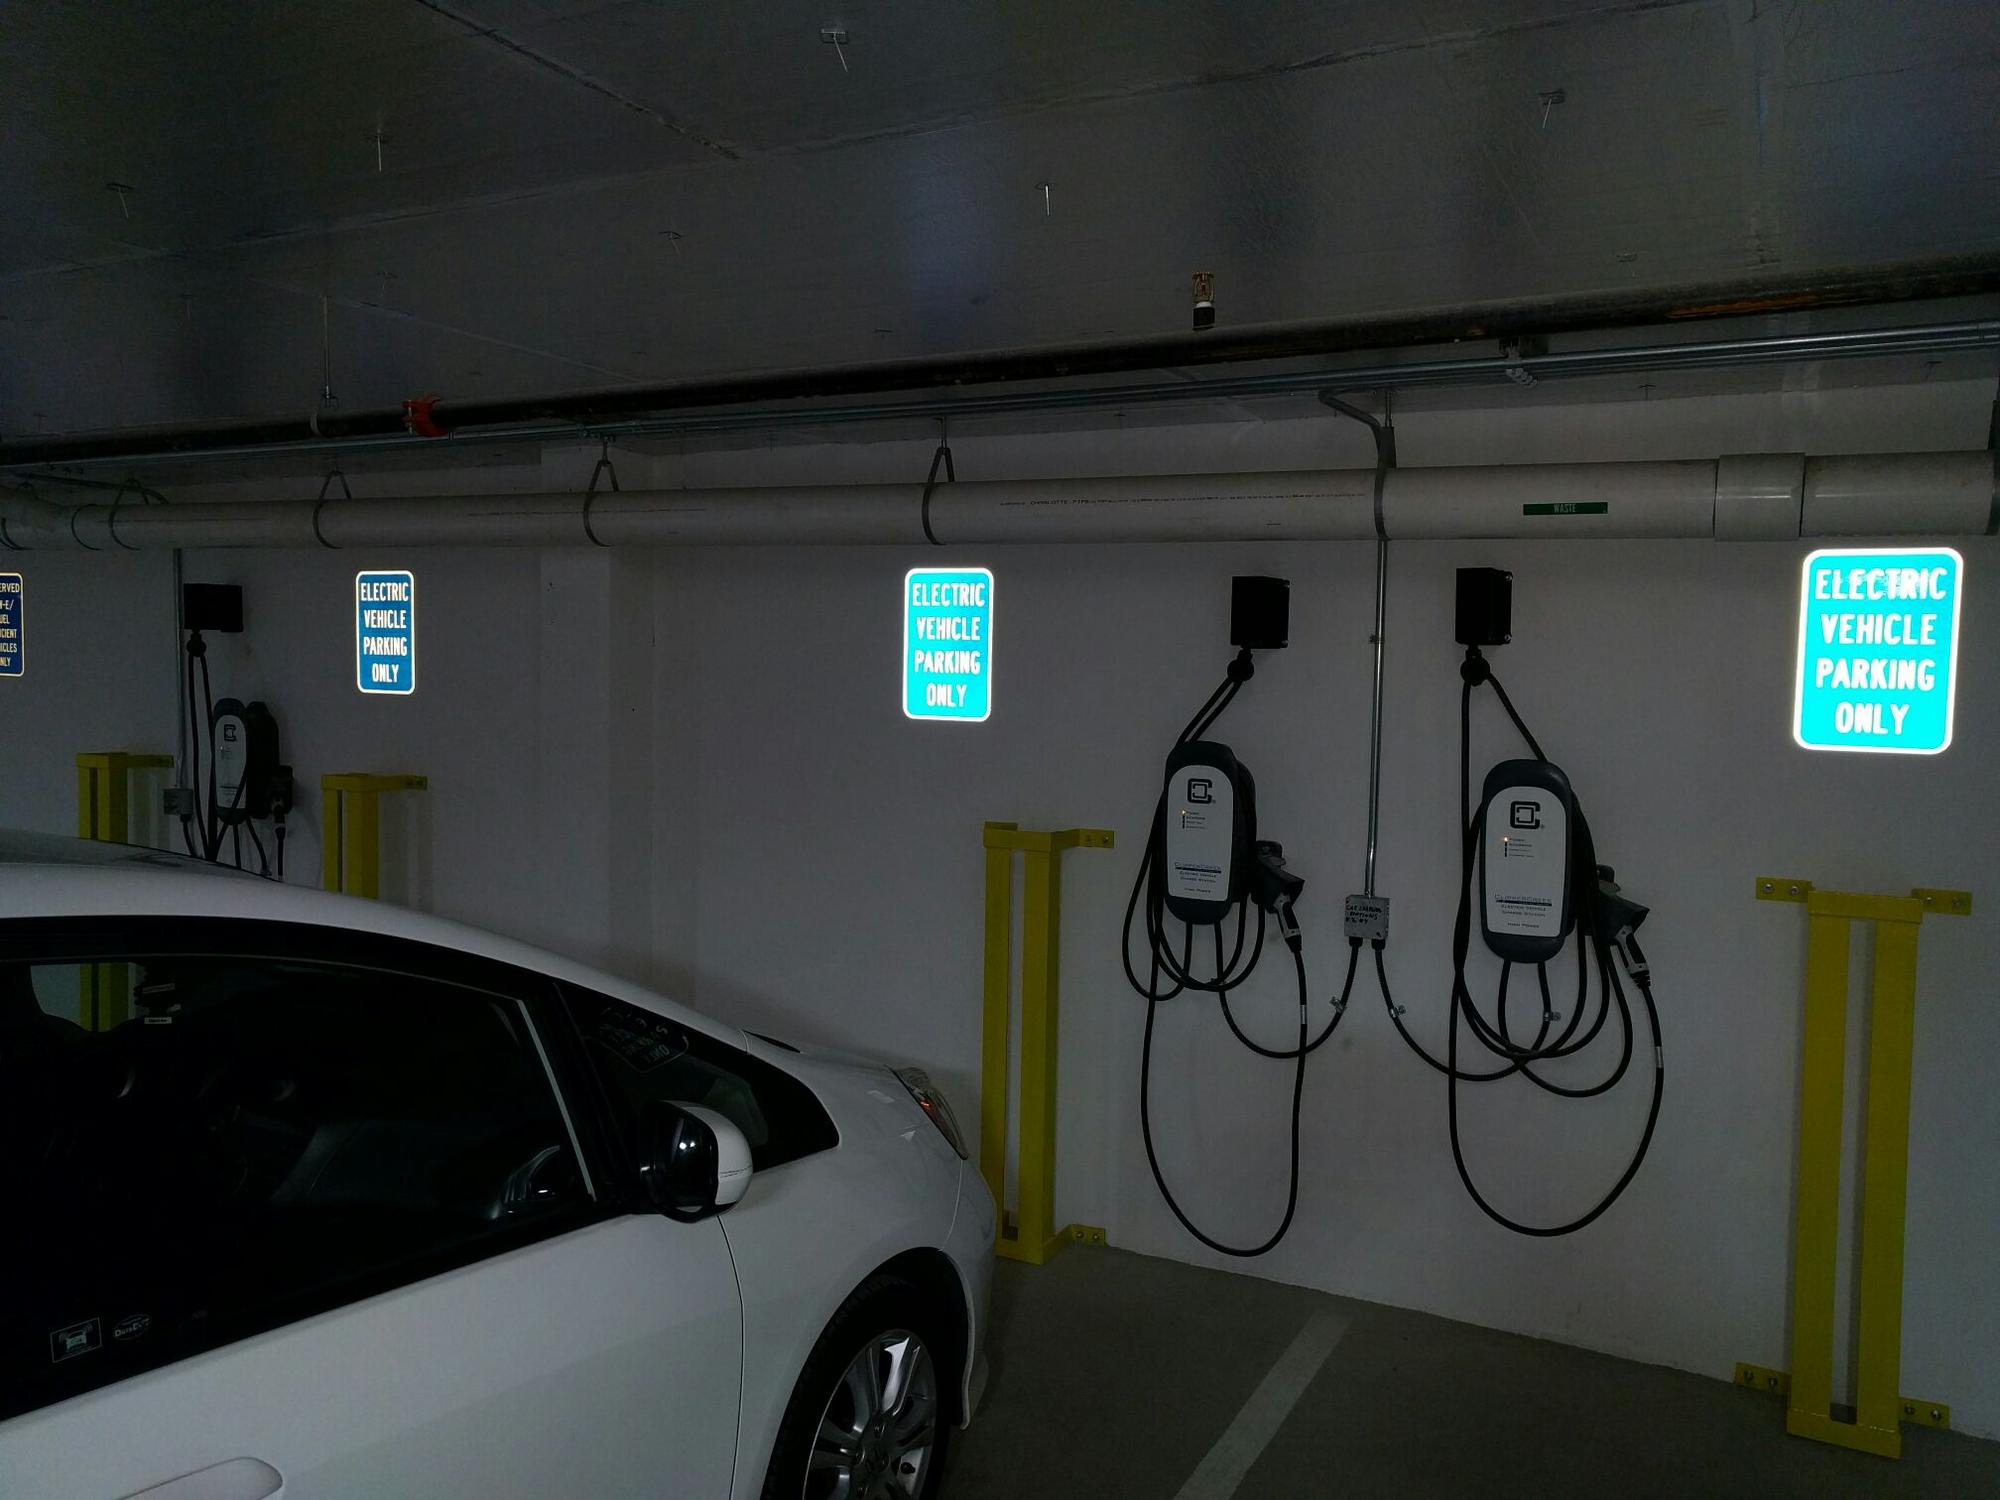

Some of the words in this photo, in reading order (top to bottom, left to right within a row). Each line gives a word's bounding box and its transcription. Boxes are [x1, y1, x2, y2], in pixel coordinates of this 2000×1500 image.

[1553, 503, 1577, 513] WASTE
[361, 582, 409, 602] ELECTRIC
[912, 582, 986, 607] ELECTRIC
[1815, 567, 1948, 601] ELECTRIC
[363, 609, 407, 629] VEHICLE
[916, 616, 981, 641] VEHICLE
[1820, 612, 1938, 645] VEHICLE
[363, 636, 408, 657] PARKING
[372, 663, 399, 683] ONLY
[914, 649, 981, 676] PARKING
[1815, 657, 1936, 692] PARKING
[926, 682, 968, 708] ONLY
[1834, 701, 1910, 735] ONLY
